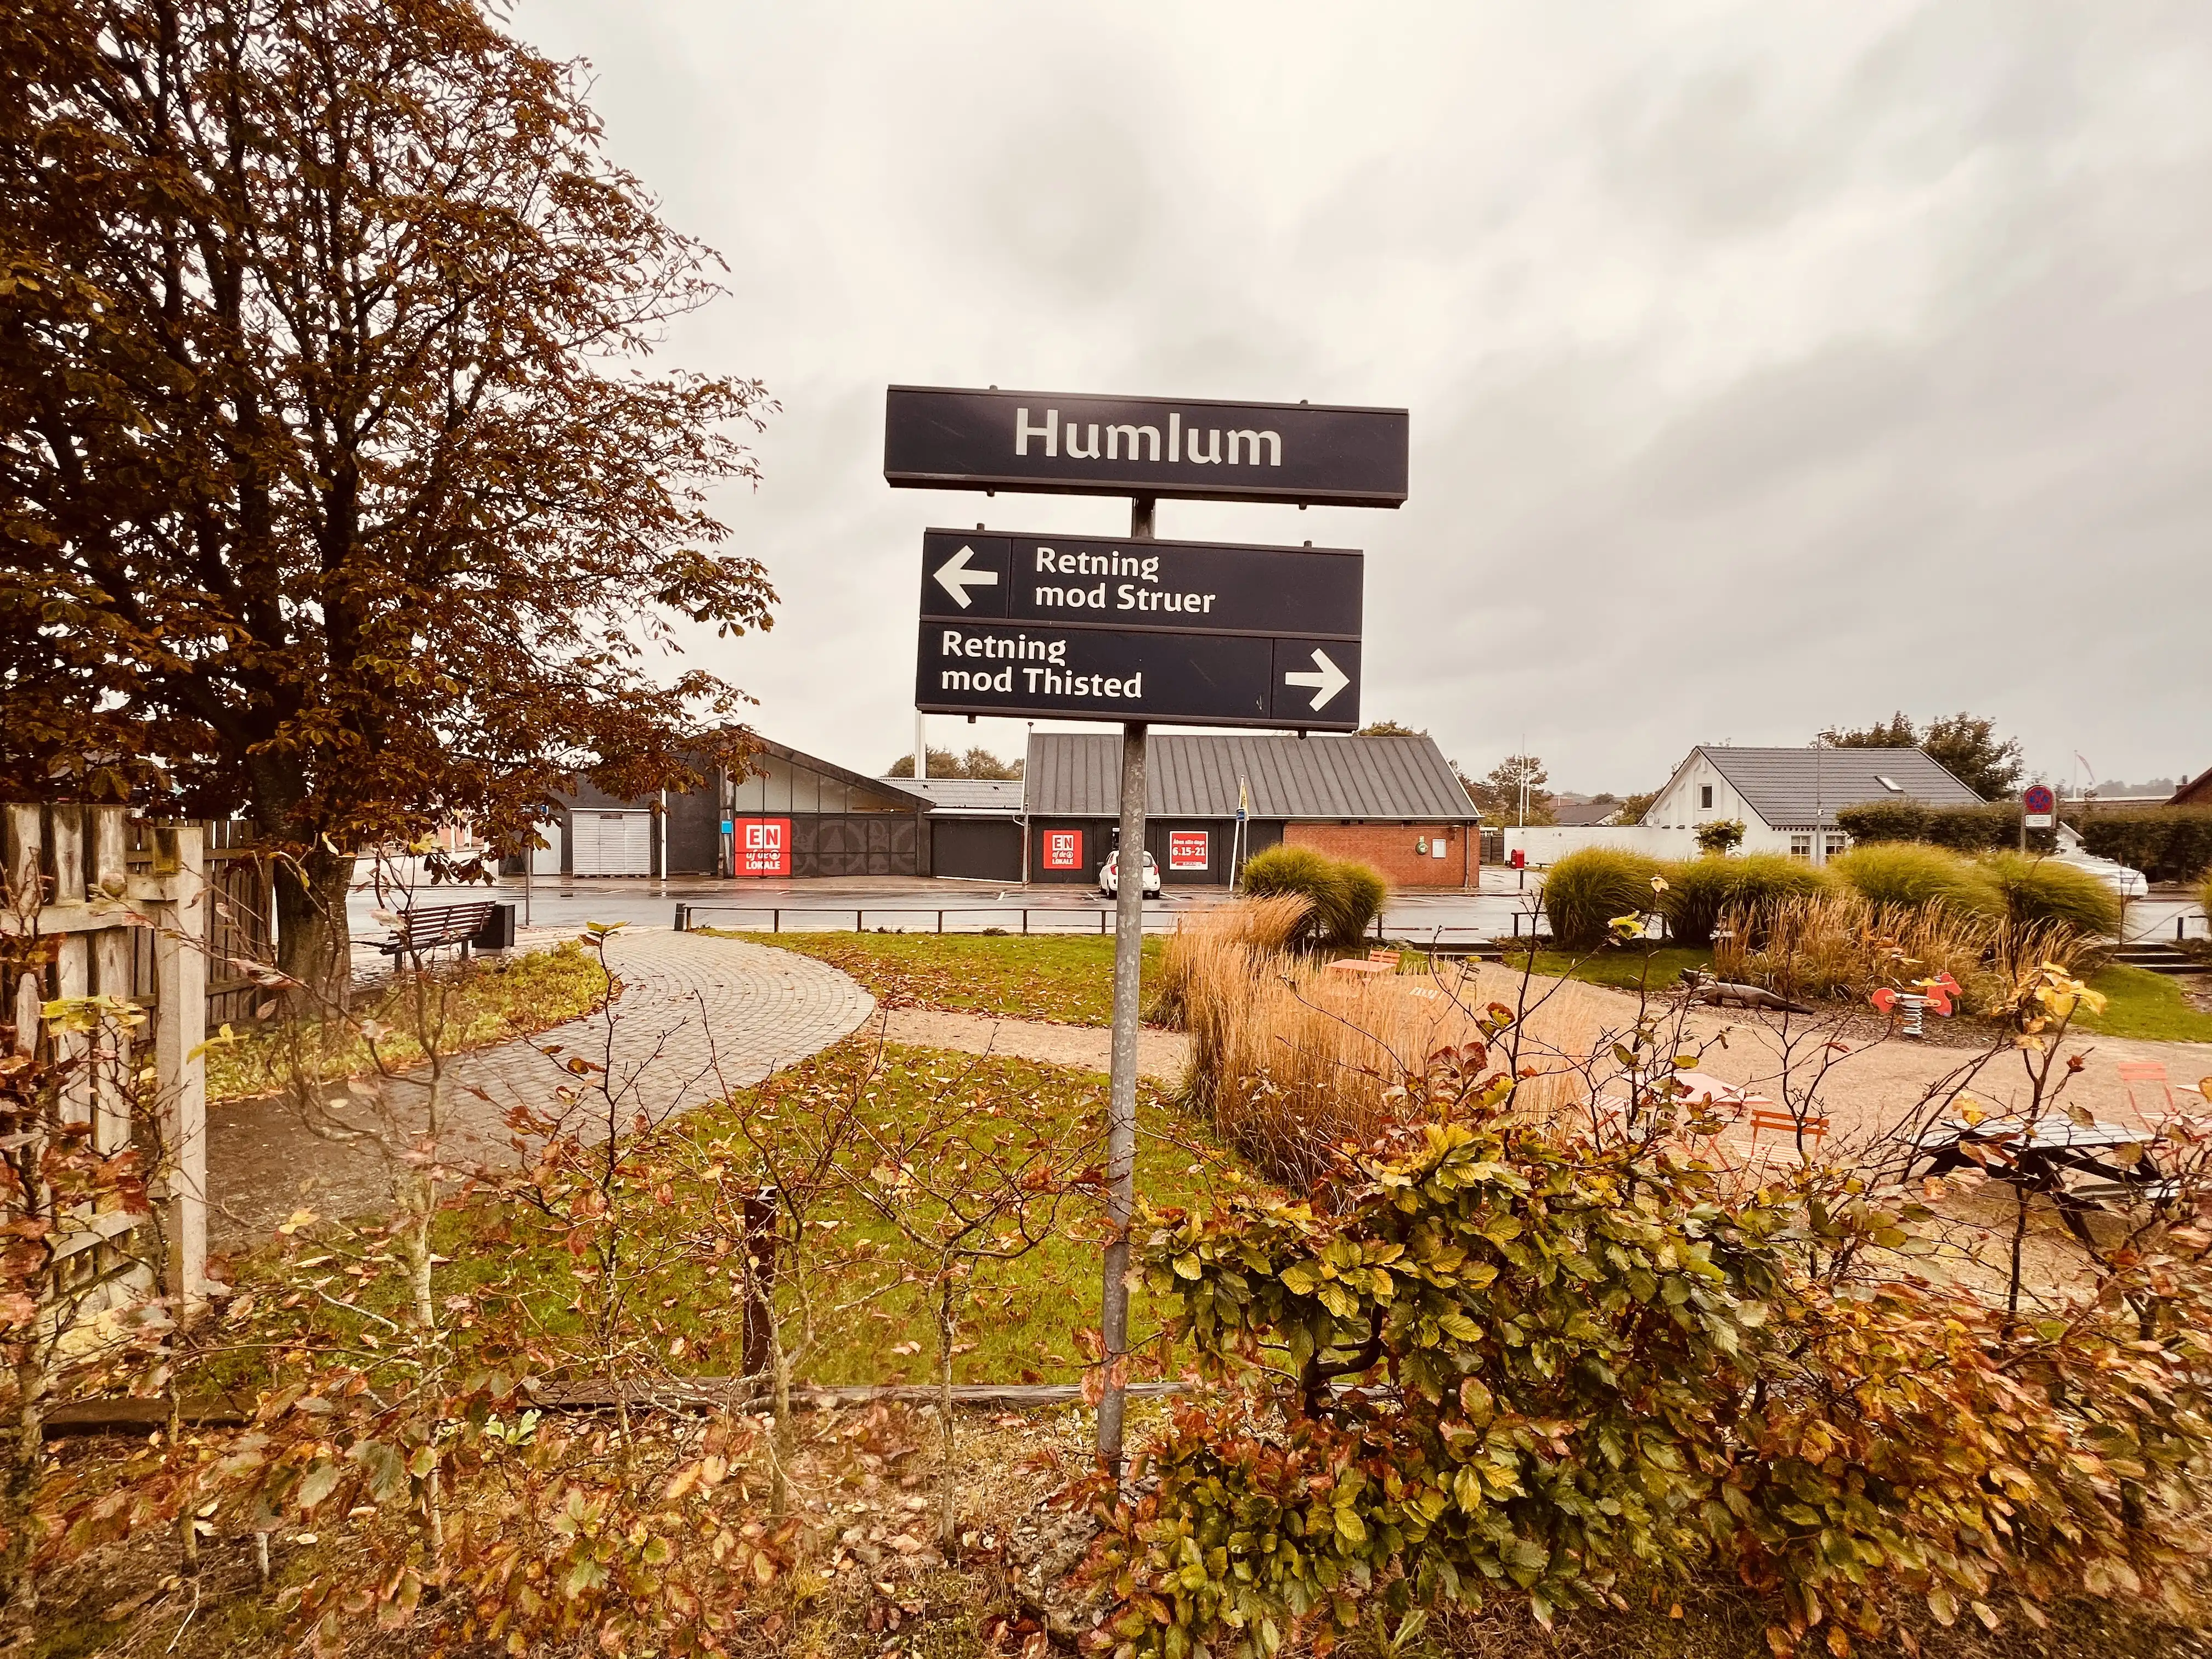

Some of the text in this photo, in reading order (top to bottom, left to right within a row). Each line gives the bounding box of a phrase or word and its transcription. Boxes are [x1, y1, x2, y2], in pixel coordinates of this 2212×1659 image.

[1015, 408, 1282, 466] Humlum
[1036, 547, 1159, 583] Retning
[1035, 582, 1216, 613] mod Struer
[943, 630, 1066, 667] Retning
[942, 666, 1142, 698] mod Thisted
[749, 828, 778, 845] EN
[1054, 837, 1072, 849] EN
[1172, 847, 1205, 856] 6.15-21
[746, 861, 781, 870] LOKALE
